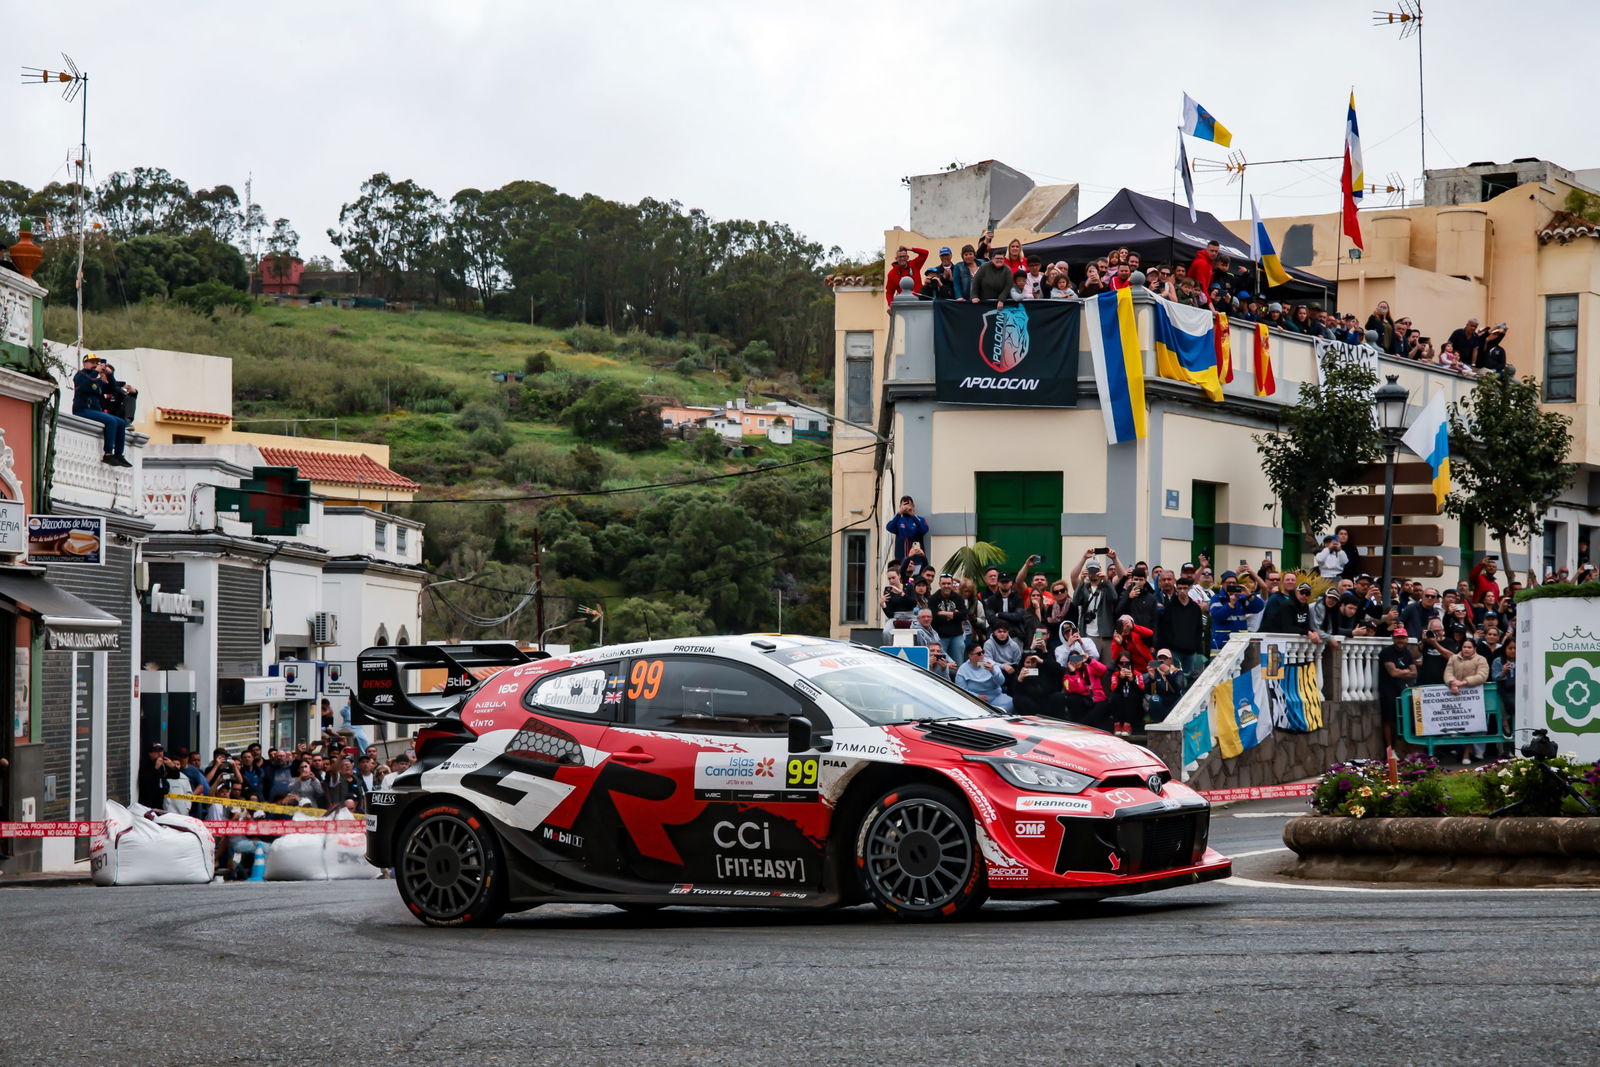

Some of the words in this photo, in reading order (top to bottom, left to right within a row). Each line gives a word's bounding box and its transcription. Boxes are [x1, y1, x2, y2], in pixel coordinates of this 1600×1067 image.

[959, 377, 1040, 390] APOLOCAN
[41, 518, 72, 530] Bizcochos
[72, 519, 80, 529] de
[80, 519, 99, 531] Moya
[57, 632, 75, 648] BAZAR
[75, 633, 101, 648] DULCERIA
[101, 633, 119, 648] PONCE
[673, 645, 716, 654] PROTERIAL
[1552, 642, 1600, 651] DORAMAS
[362, 680, 392, 688] DENSO
[447, 675, 471, 687] Stilo
[628, 660, 664, 700] 99
[1422, 695, 1480, 704] RECONOCIMIENTO
[836, 742, 888, 755] TAMADIC
[729, 756, 755, 767] Islas
[823, 760, 848, 768] PIAA
[1022, 753, 1090, 773] codebeamer
[705, 765, 754, 777] Canarias
[788, 759, 818, 785] 99
[371, 793, 396, 803] ENDLESS
[950, 767, 997, 821] Panasonic
[1105, 790, 1135, 805] CCi
[713, 820, 771, 850] CCi
[1015, 823, 1046, 835] OMP
[543, 827, 572, 845] Mobil
[733, 889, 770, 897] GAZOO
[771, 890, 807, 899] Racing
